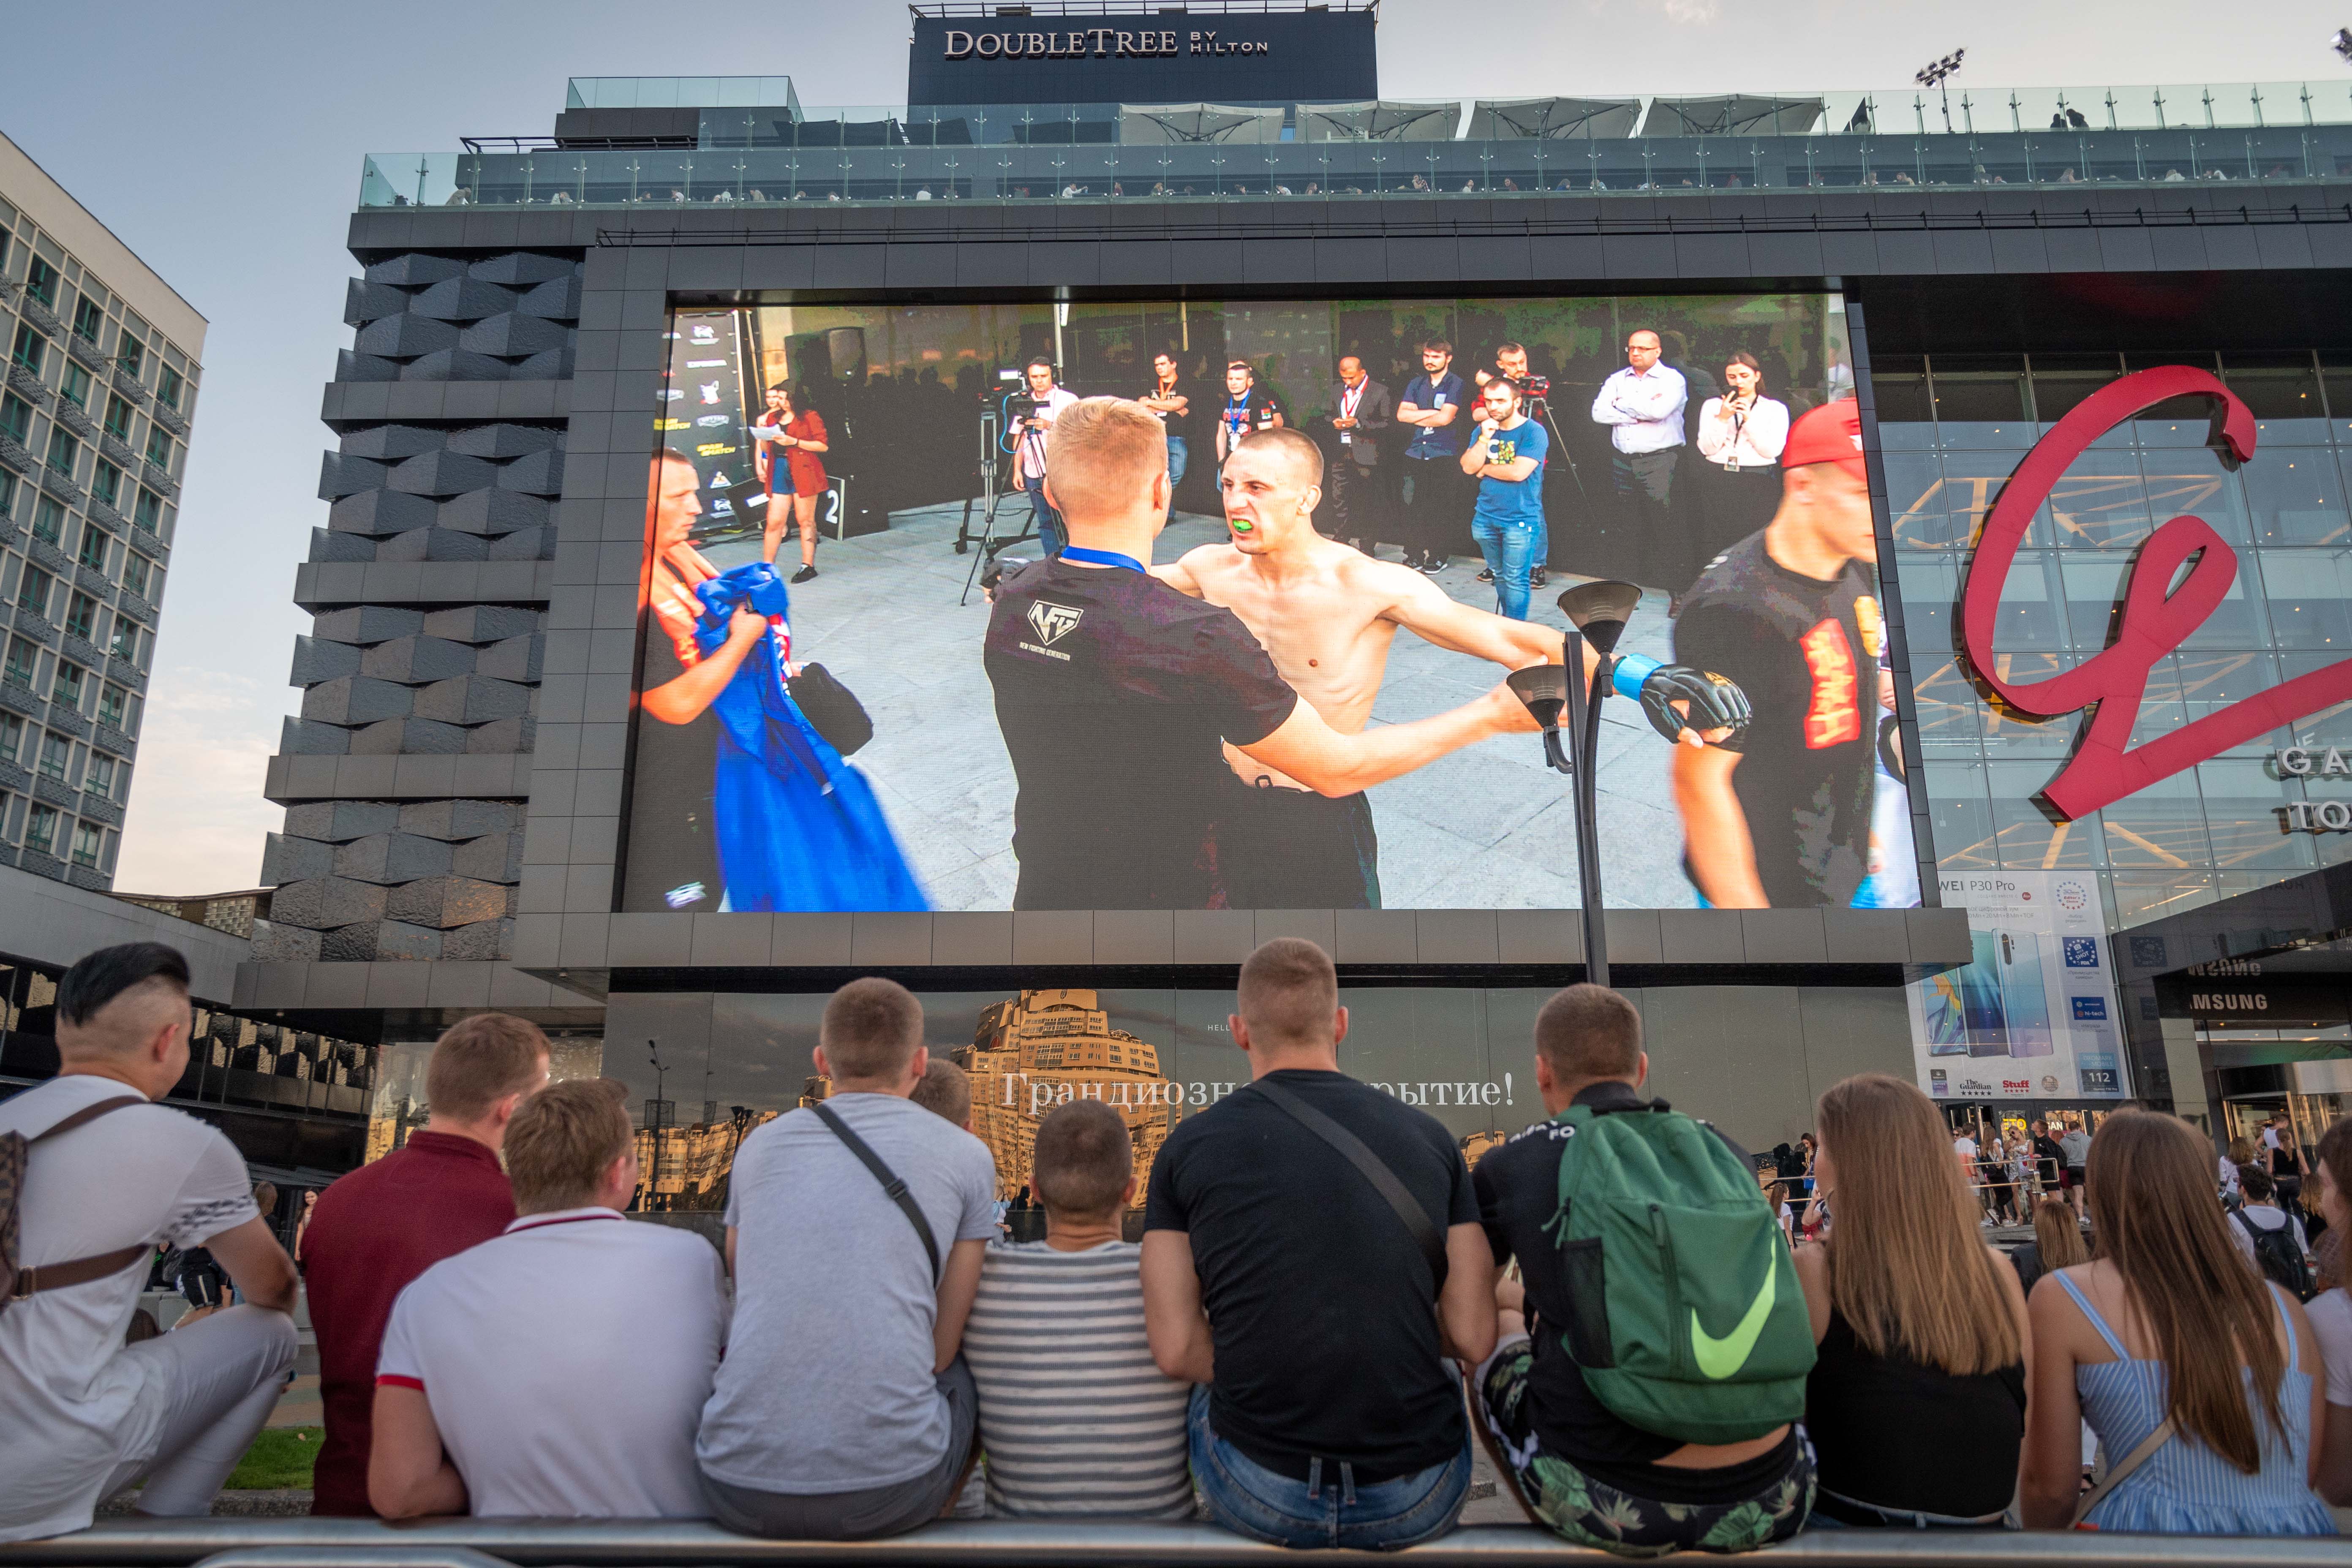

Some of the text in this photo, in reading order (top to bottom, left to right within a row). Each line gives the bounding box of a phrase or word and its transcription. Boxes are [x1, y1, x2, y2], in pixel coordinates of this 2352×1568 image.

[1190, 31, 1217, 41] BY
[1190, 42, 1268, 52] HILTON
[825, 490, 839, 524] 2
[2282, 746, 2351, 774] GA
[1970, 881, 1992, 891] P30
[1996, 881, 2015, 891] Pro
[2075, 951, 2089, 960] SHOT
[2190, 994, 2268, 1010] MSUNG
[2088, 1072, 2111, 1082] 112
[2003, 1080, 2030, 1088] Stuff
[1001, 1073, 1252, 1115] Грандиозн
[2048, 1122, 2063, 1130] AN
